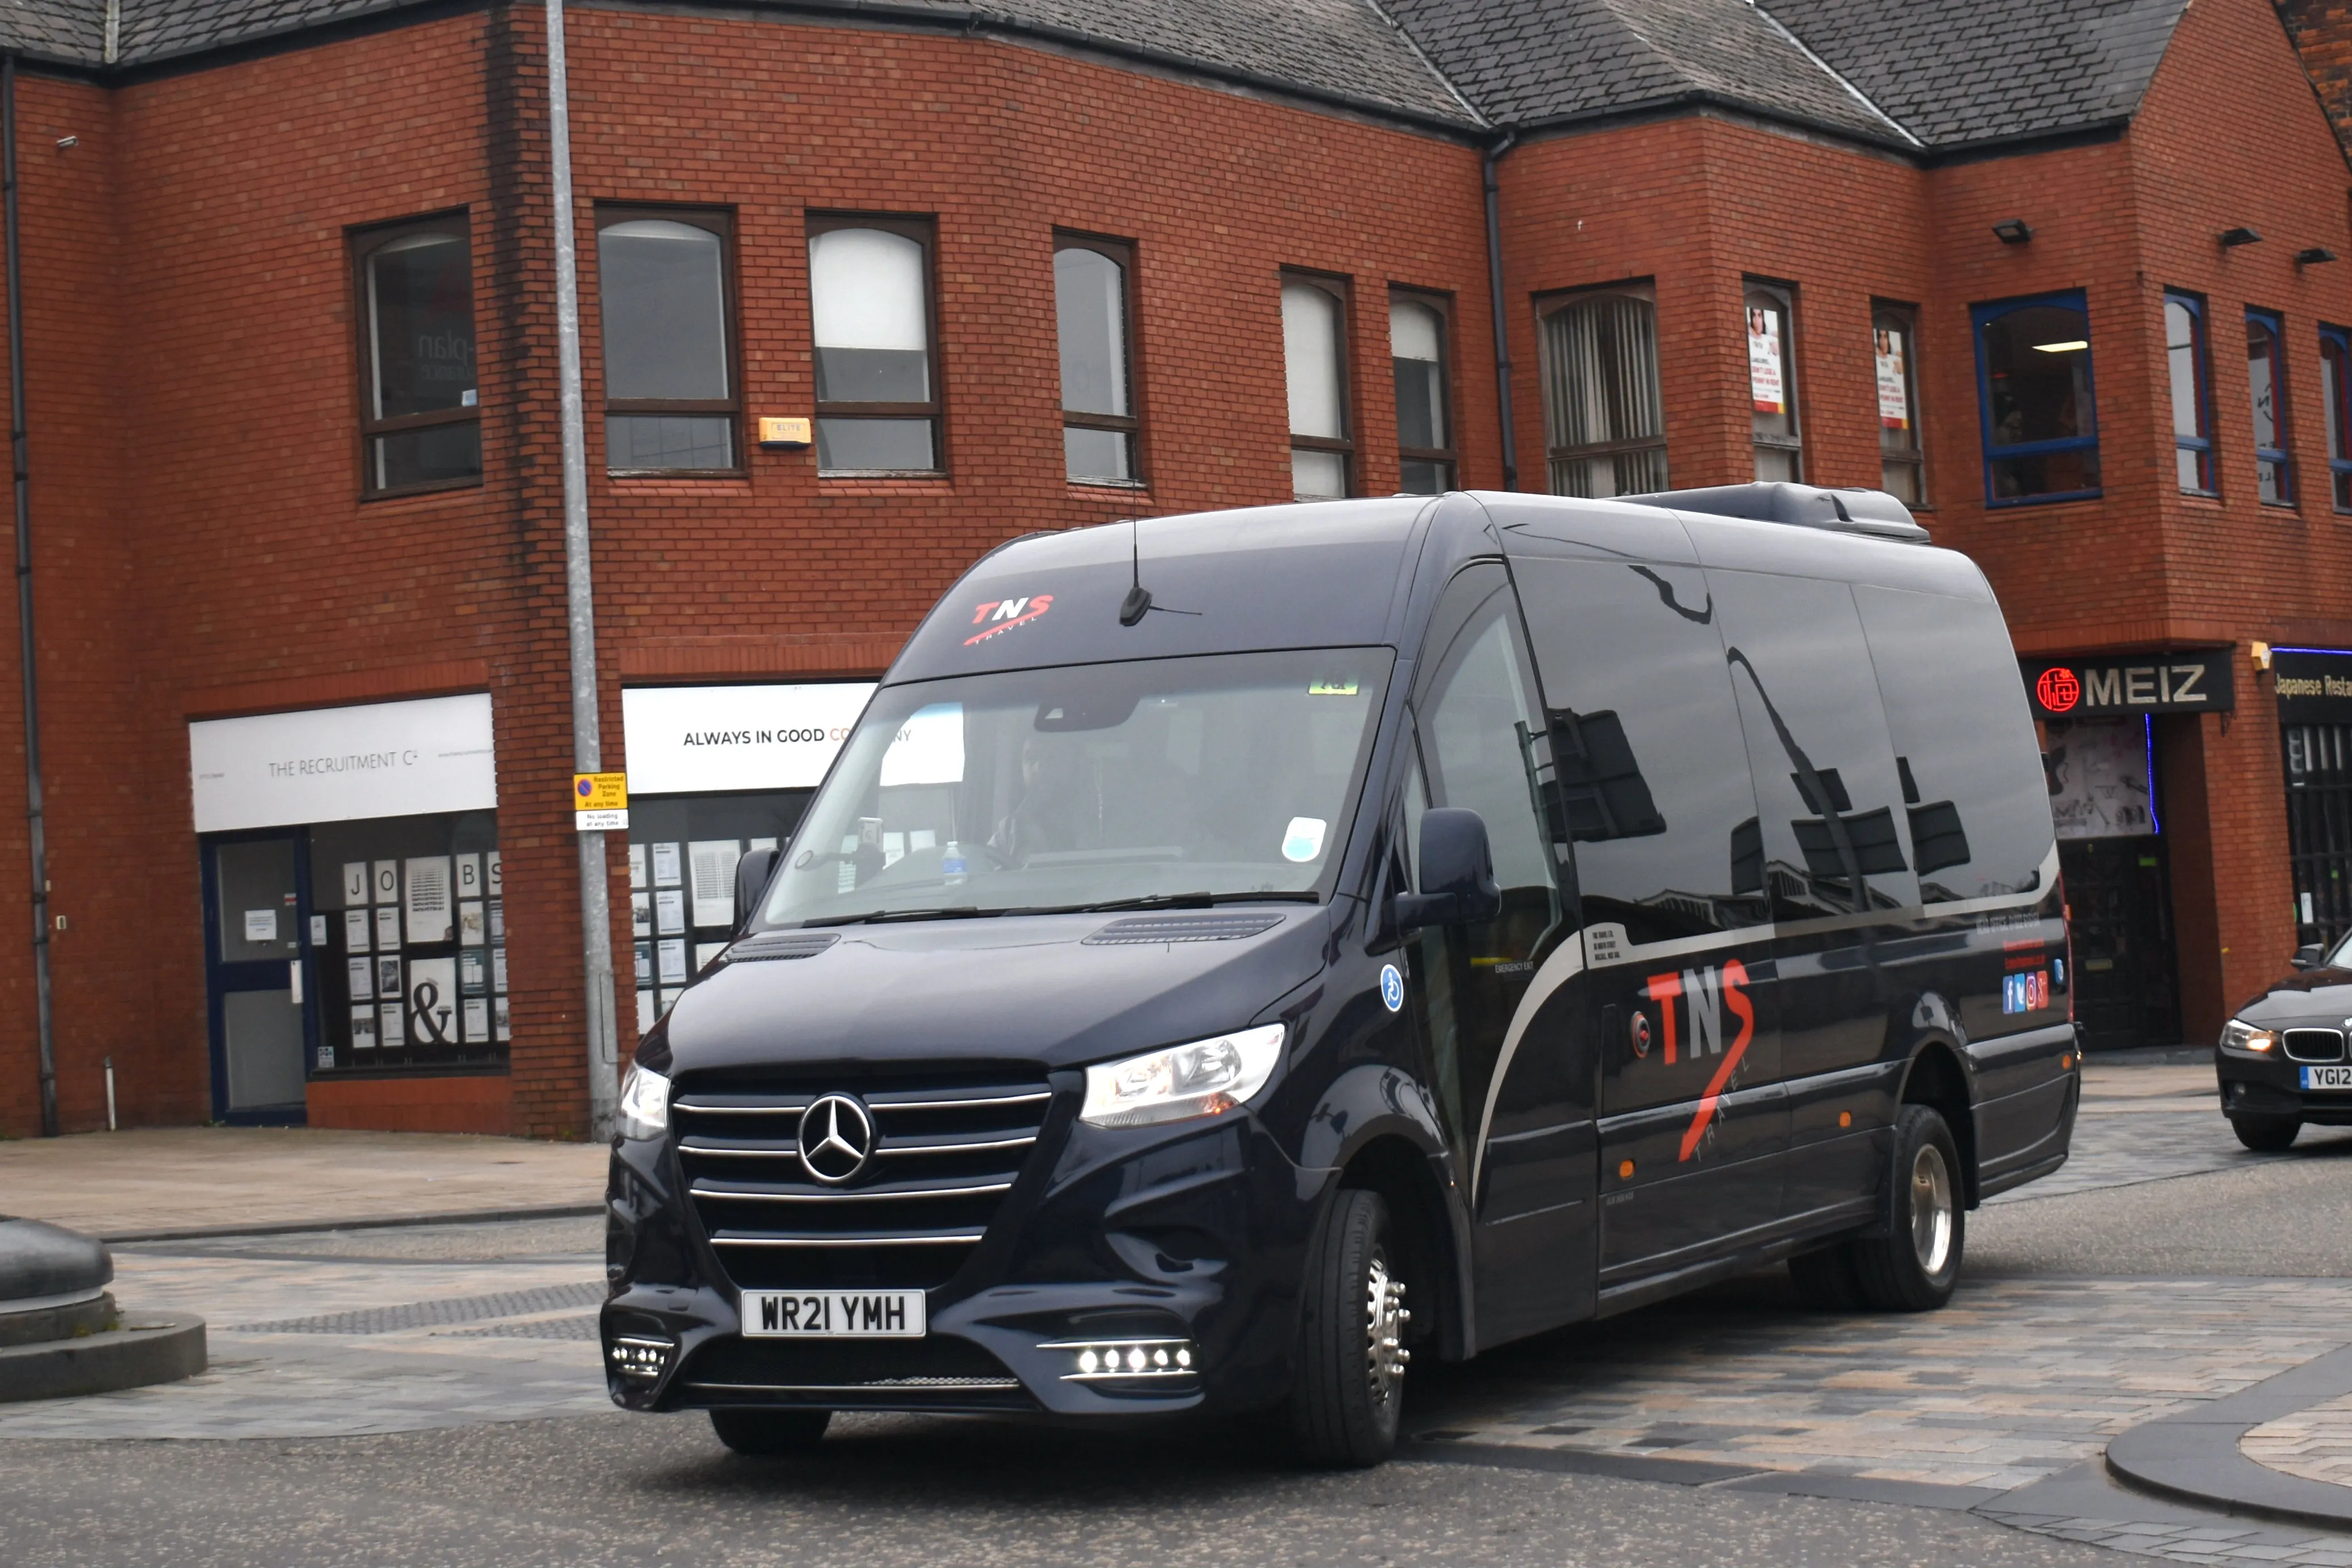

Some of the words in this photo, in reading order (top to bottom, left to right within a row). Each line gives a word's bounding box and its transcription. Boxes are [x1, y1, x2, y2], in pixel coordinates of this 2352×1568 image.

[2084, 664, 2207, 707] MEIZ
[2274, 673, 2323, 699] Japanese
[683, 730, 751, 746] ALWAYS
[756, 730, 772, 743] IN
[777, 728, 825, 743] GOOD
[269, 760, 295, 777] THE
[299, 751, 397, 775] RECRUITMENT
[1495, 962, 1523, 974] EMERGENCY
[1524, 961, 1534, 970] EXIT
[2314, 1068, 2351, 1085] YG12
[761, 1295, 831, 1331] WR21
[841, 1295, 905, 1331] YMH
